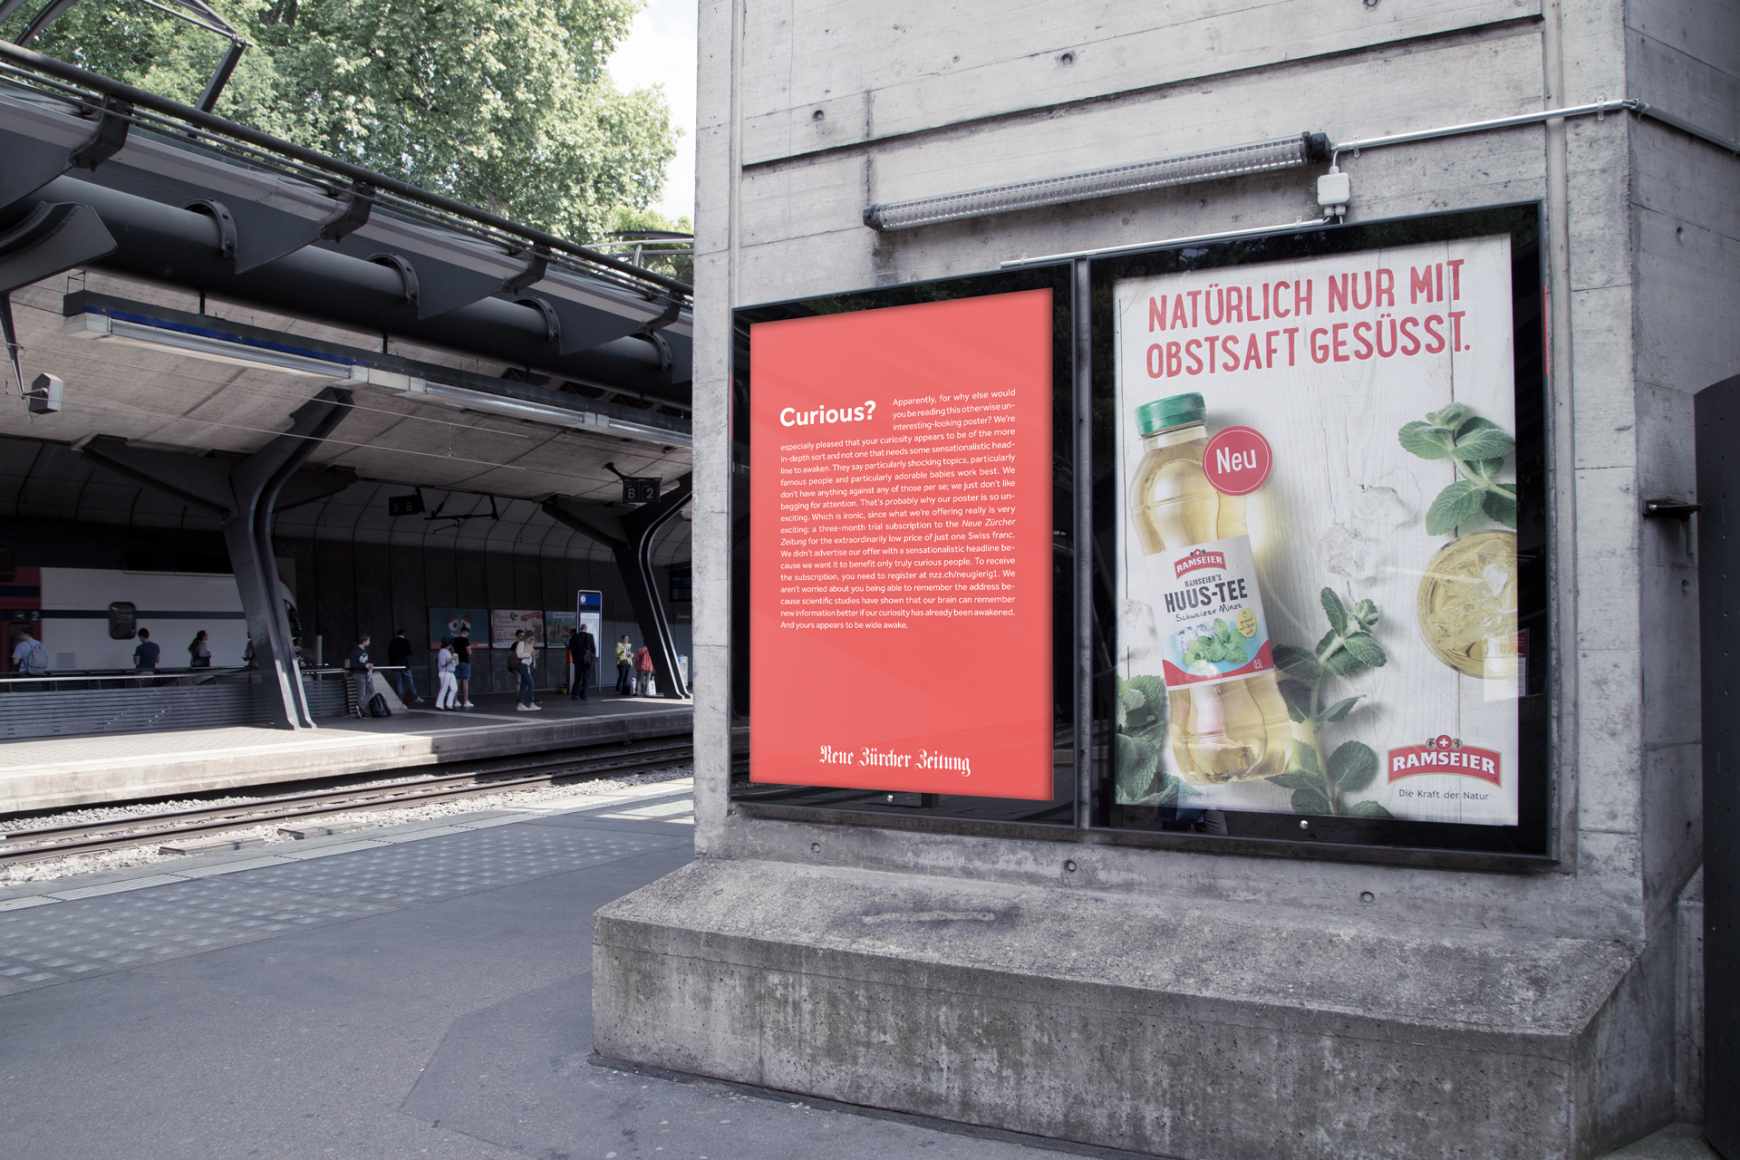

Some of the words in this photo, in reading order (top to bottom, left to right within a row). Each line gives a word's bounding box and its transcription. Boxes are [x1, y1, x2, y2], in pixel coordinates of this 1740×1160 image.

[1148, 278, 1313, 332] NATÜRLICH
[1328, 268, 1396, 314] NUR
[1410, 259, 1465, 304] MIT
[1146, 327, 1300, 379] OBSTSAFT
[1310, 311, 1472, 364] GESÜSST.
[971, 390, 988, 398] else
[990, 387, 1015, 397] would
[780, 400, 876, 427] Curious?
[917, 406, 945, 417] reading
[946, 405, 960, 413] this
[961, 402, 1000, 412] otherwise
[892, 418, 962, 432] interesting-looking
[962, 416, 992, 427] poster?
[993, 414, 1015, 423] We're
[780, 441, 814, 452] especially
[815, 439, 843, 449] pleased
[844, 438, 860, 446] that
[861, 438, 878, 446] your
[879, 434, 912, 445] curiosity
[913, 433, 944, 443] appears
[780, 453, 810, 463] in-depth
[811, 452, 825, 460] sort
[869, 448, 884, 456] that
[885, 447, 908, 455] needs
[931, 442, 990, 453] sensationalistic
[1216, 447, 1257, 475] Neu
[808, 476, 832, 486] people
[850, 473, 891, 484] particularly
[894, 471, 927, 480] adorable
[929, 469, 955, 478] babies
[957, 468, 976, 476] work
[817, 487, 847, 497] anything
[849, 486, 874, 496] against
[900, 483, 921, 492] those
[963, 481, 977, 490] just
[979, 480, 1000, 488] don't
[1002, 479, 1015, 487] like
[780, 501, 809, 511] begging
[860, 498, 883, 506] That's
[884, 496, 918, 506] probably
[952, 493, 978, 504] poster
[811, 512, 833, 520] Which
[867, 510, 886, 518] since
[888, 509, 907, 517] what
[909, 508, 929, 516] we're
[931, 507, 963, 517] offering
[964, 506, 986, 516] really
[997, 506, 1015, 514] very
[818, 523, 865, 532] three-month
[867, 522, 883, 530] trial
[885, 521, 931, 531] subscription
[961, 519, 982, 527] Neue
[984, 517, 1015, 526] Zürcher
[780, 537, 807, 547] Zeitung
[833, 535, 887, 545] extraordinarily
[903, 533, 922, 543] price
[933, 533, 948, 542] just
[967, 531, 989, 539] Swiss
[1176, 556, 1223, 574] RAMSEIER
[1164, 578, 1248, 613] HUUS-TEE
[795, 622, 814, 630] yours
[815, 622, 843, 630] appears
[819, 745, 854, 765] Neue
[858, 747, 911, 768] Zürcher
[915, 749, 971, 777] Zeitung
[1392, 751, 1496, 774] RAMSEIER
[1399, 788, 1414, 798] Die
[1417, 790, 1440, 799] Kraft
[1444, 790, 1460, 800] der
[1463, 791, 1489, 800] Natur
